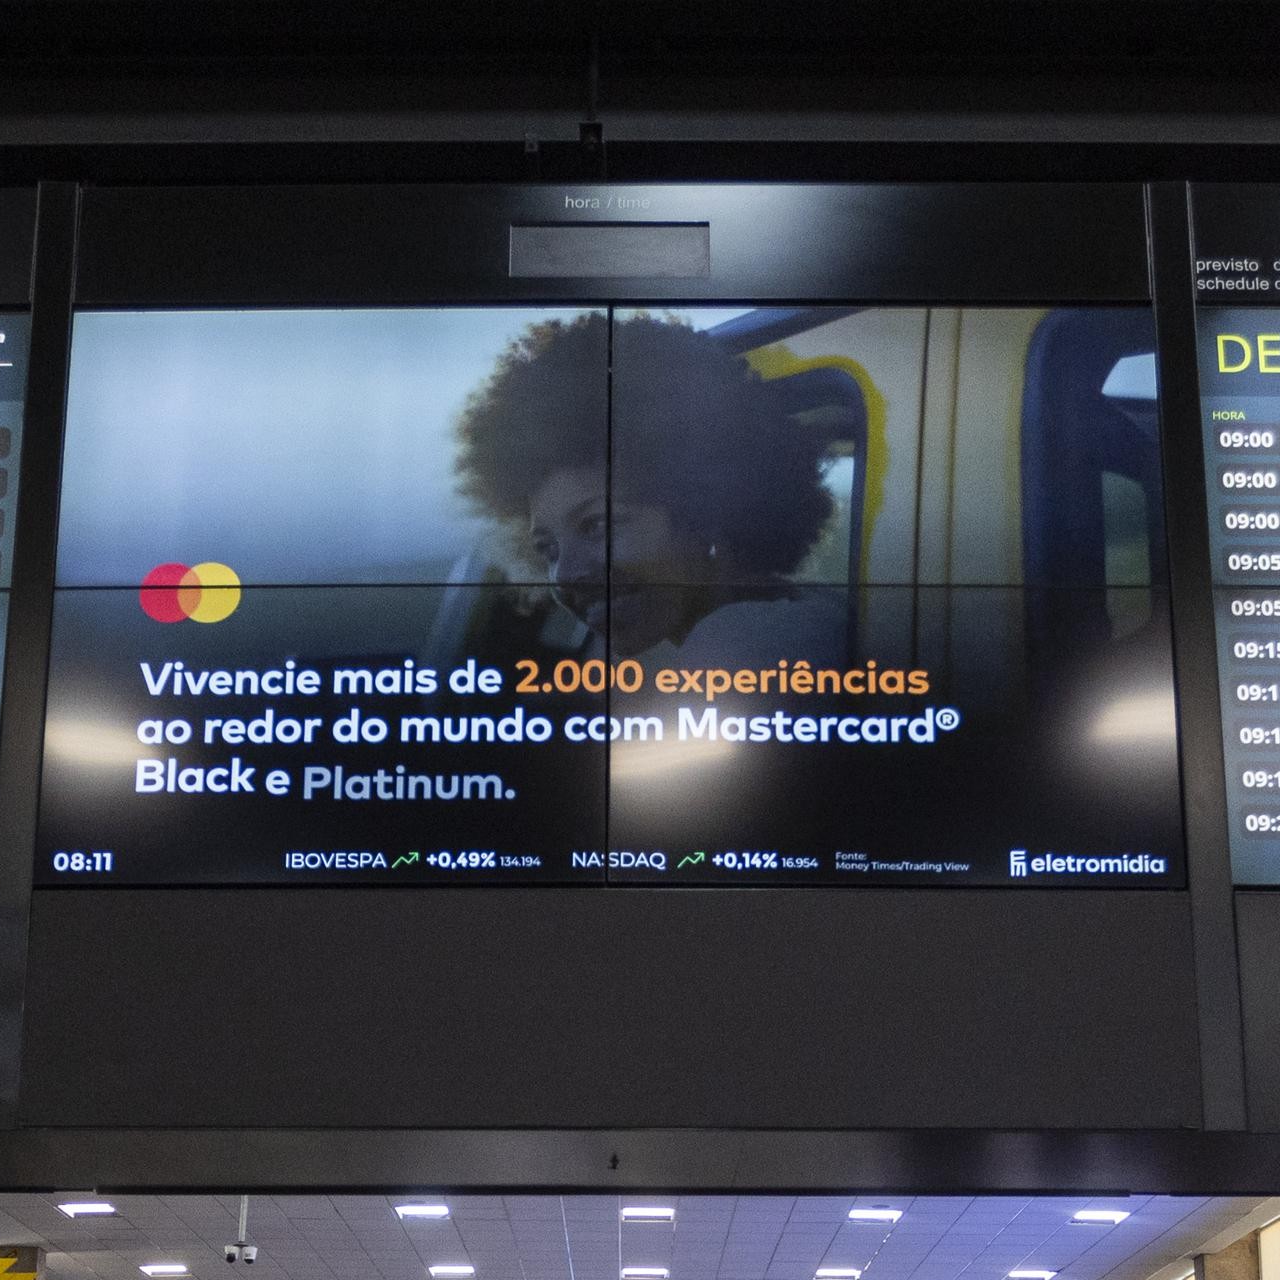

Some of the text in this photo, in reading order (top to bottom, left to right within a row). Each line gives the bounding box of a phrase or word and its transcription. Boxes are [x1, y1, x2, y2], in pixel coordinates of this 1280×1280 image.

[565, 196, 600, 208] hora
[617, 196, 651, 209] time
[1212, 411, 1245, 421] HORA
[1220, 432, 1273, 448] 09:00
[140, 659, 929, 701] Vivencie mais de 2.000 experiências
[137, 716, 191, 744] ao
[204, 709, 321, 743] redor
[333, 708, 387, 743] do
[400, 707, 552, 742] mundo
[564, 715, 663, 742] com
[136, 759, 516, 800] Black e Platinum.
[53, 851, 818, 871] 08:11 IBOVESPA +0,49% 134.194 NASDAQ +0,14% 16.954
[835, 851, 867, 861] Fonte:
[1030, 853, 1166, 874] eletromidia
[835, 861, 970, 873] Money Times/Trading View
